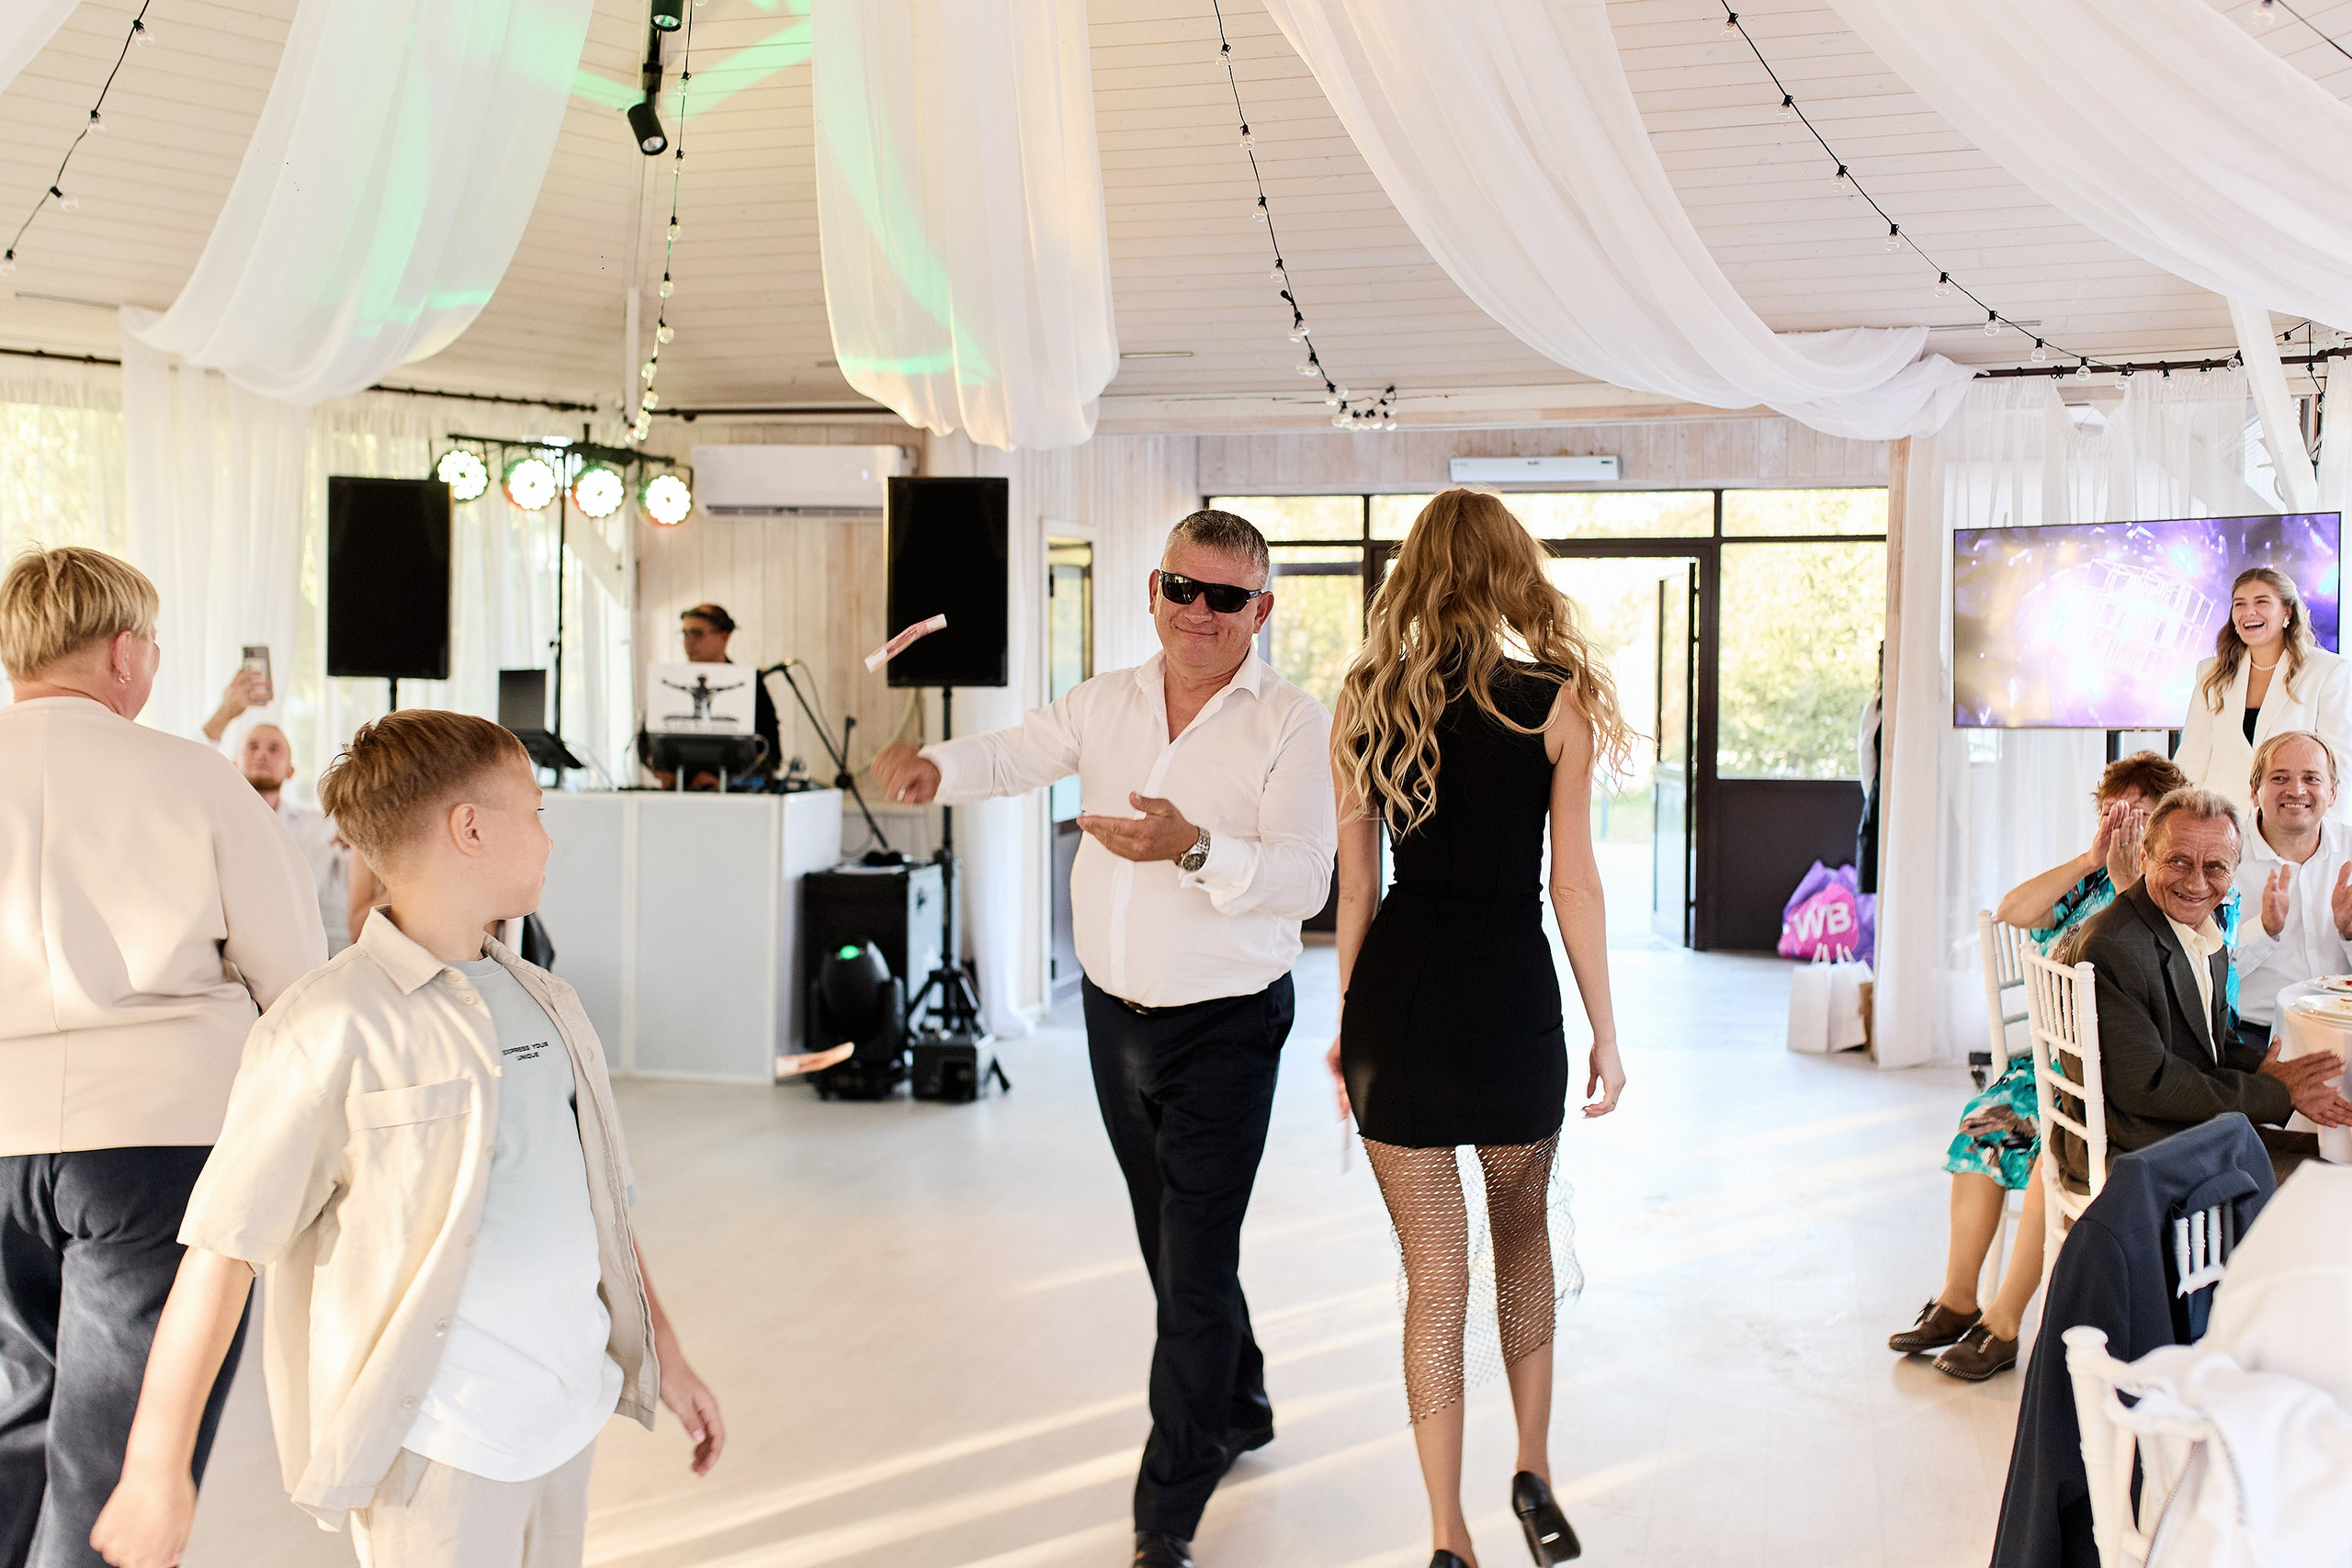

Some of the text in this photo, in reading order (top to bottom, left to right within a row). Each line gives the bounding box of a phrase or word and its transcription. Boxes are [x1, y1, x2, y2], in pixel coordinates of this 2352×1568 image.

[1792, 901, 1851, 942] WB
[502, 1041, 548, 1055] EXPRESS YOUR
[516, 1051, 539, 1061] UNIQUE
